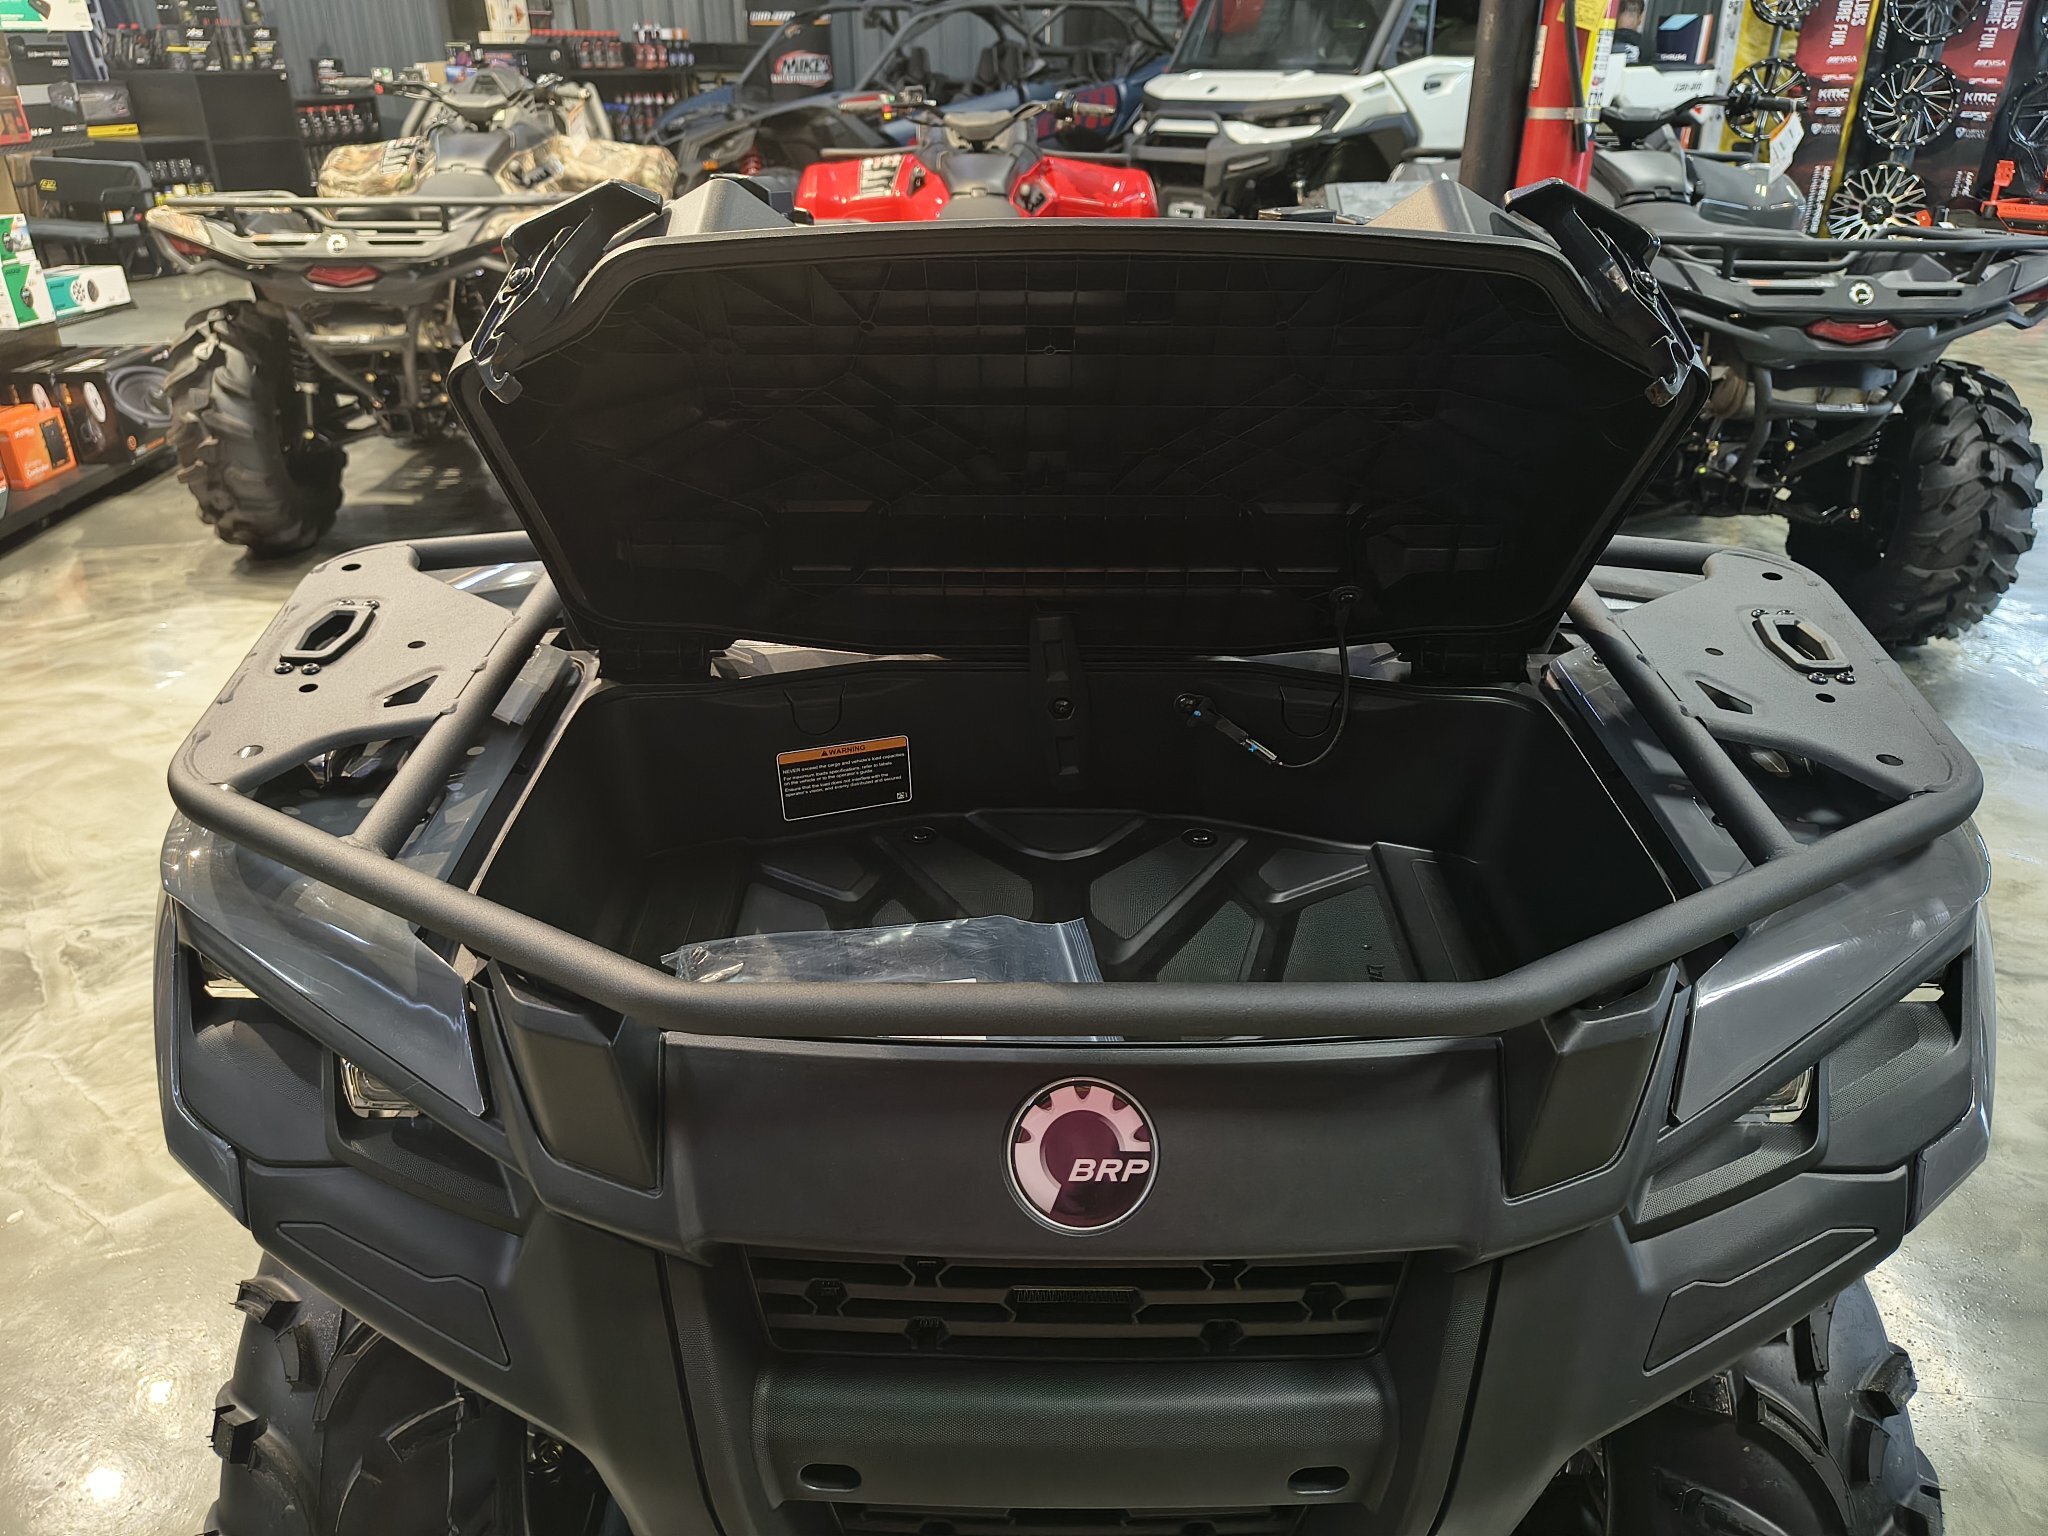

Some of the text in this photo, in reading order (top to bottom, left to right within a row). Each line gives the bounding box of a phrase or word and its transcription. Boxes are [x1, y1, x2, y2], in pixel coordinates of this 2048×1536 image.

[1835, 0, 1854, 22] ORE
[2001, 1, 2023, 30] LUGS
[1977, 27, 1999, 51] FUN.
[1818, 88, 1850, 99] KMC
[1964, 92, 1997, 102] KMC
[829, 745, 866, 755] WARNING
[1068, 1158, 1150, 1182] BRP
